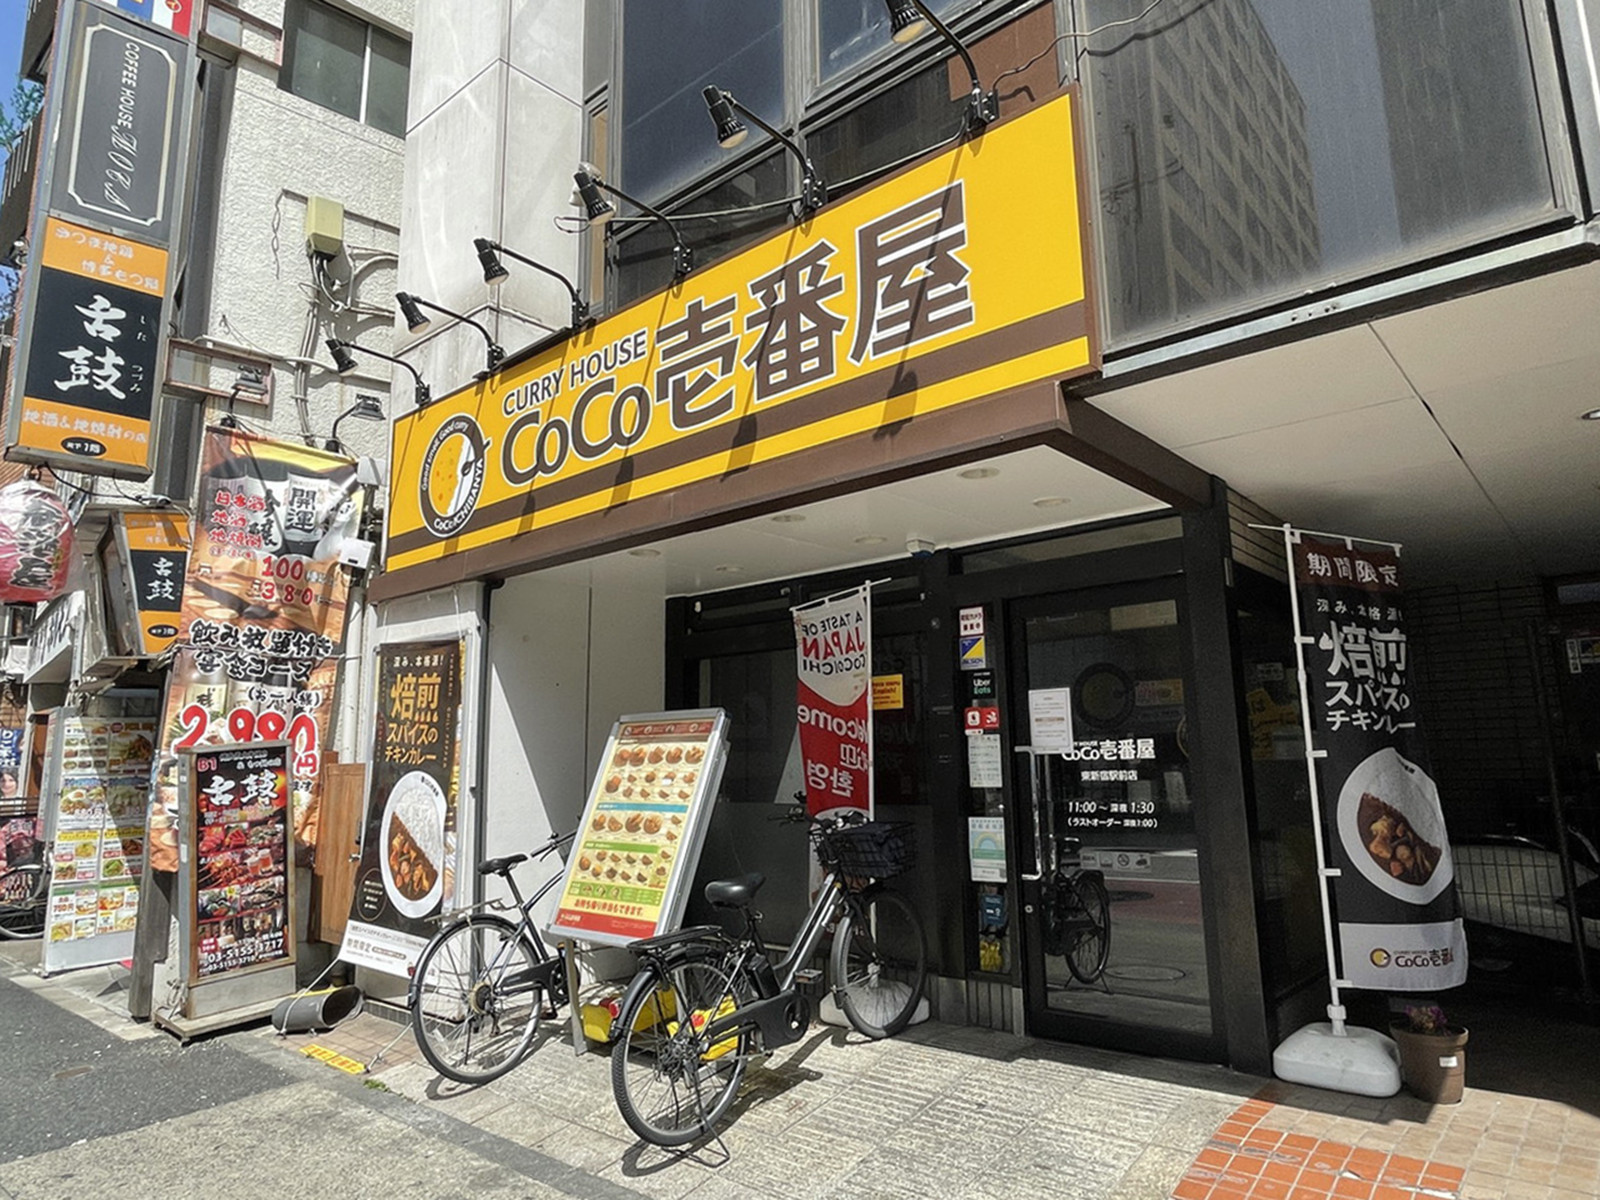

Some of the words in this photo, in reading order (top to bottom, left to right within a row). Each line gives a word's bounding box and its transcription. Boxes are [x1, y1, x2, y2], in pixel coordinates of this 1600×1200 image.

[121, 42, 140, 88] COFFEE
[117, 87, 136, 129] HOUSE
[502, 366, 566, 417] CURRY
[569, 327, 648, 389] HOUSE
[1318, 619, 1407, 686] 焙煎
[390, 672, 441, 722] 焙煎
[973, 678, 991, 687] Uber
[386, 721, 438, 745] スパイスの
[384, 745, 437, 765] チキンカレー
[1068, 801, 1097, 813] 11:00
[1130, 801, 1155, 814] 1:30
